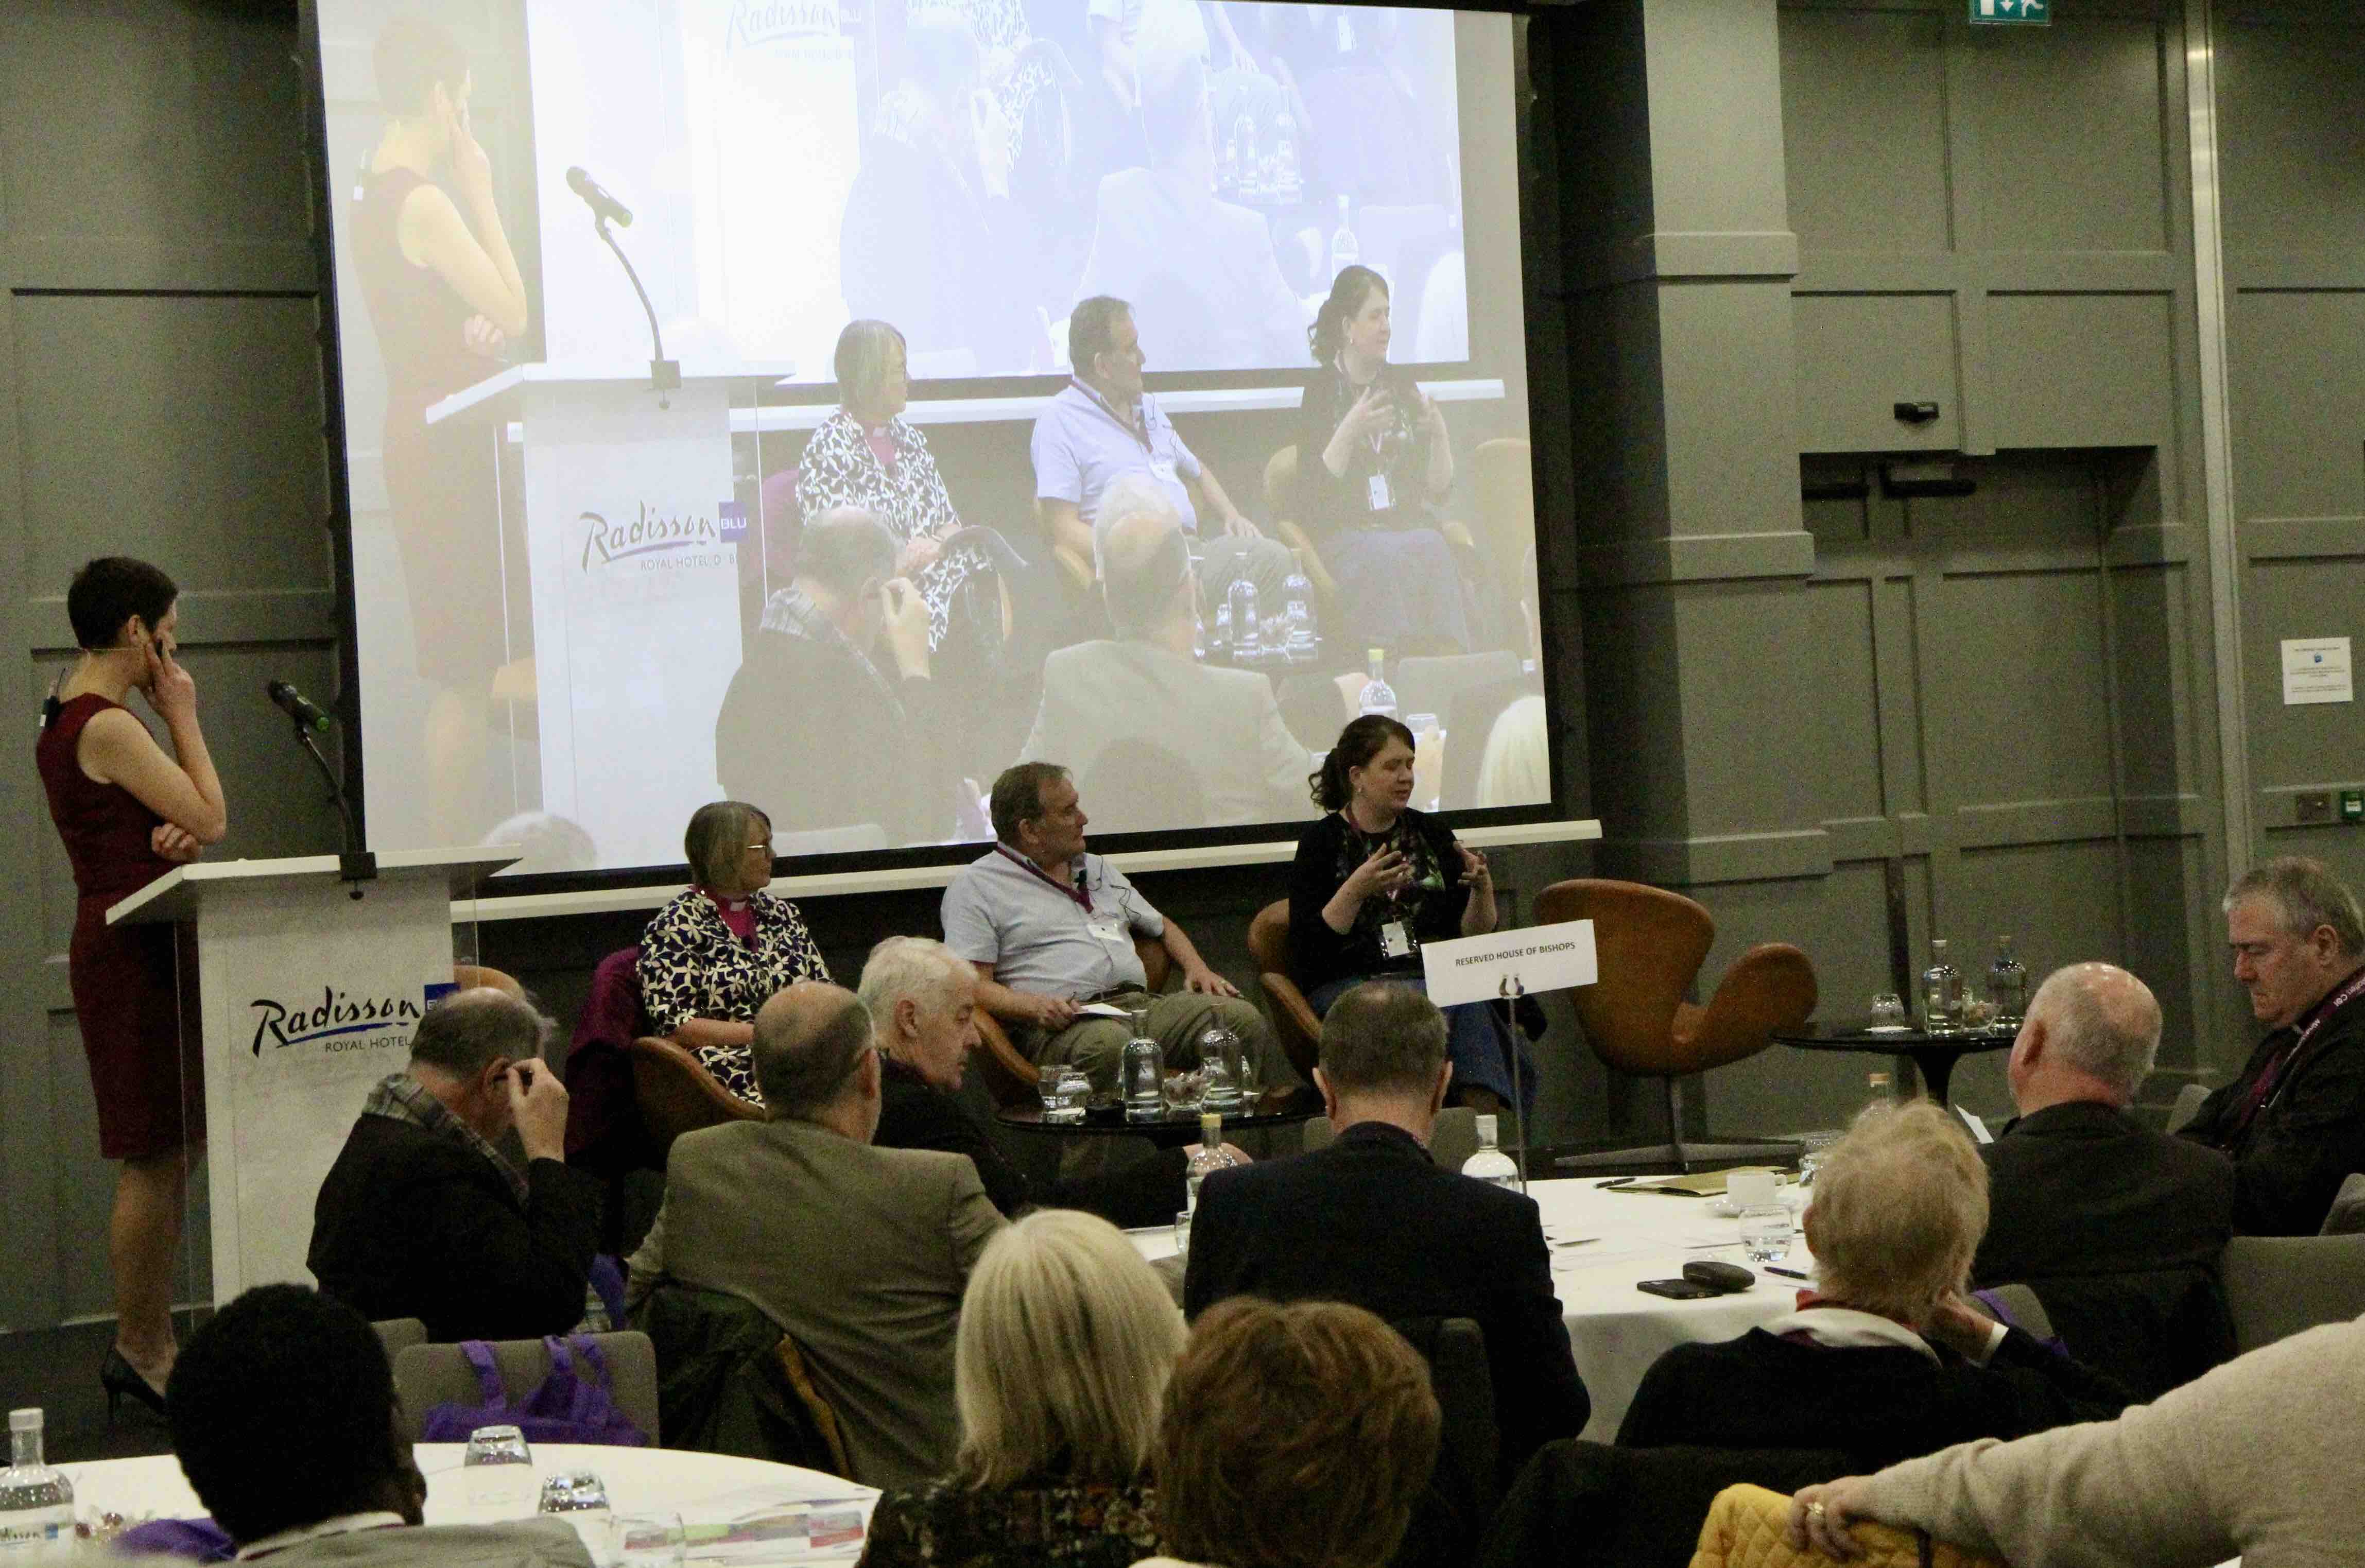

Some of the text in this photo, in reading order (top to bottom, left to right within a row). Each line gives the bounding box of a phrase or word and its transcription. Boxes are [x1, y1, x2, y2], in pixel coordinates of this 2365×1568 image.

[578, 499, 747, 575] Radisson BLU
[1455, 941, 1576, 967] RESERVED HOUSE OF BISHOPS
[250, 985, 421, 1058] Radisson
[325, 1036, 412, 1053] ROYAL HOTEL
